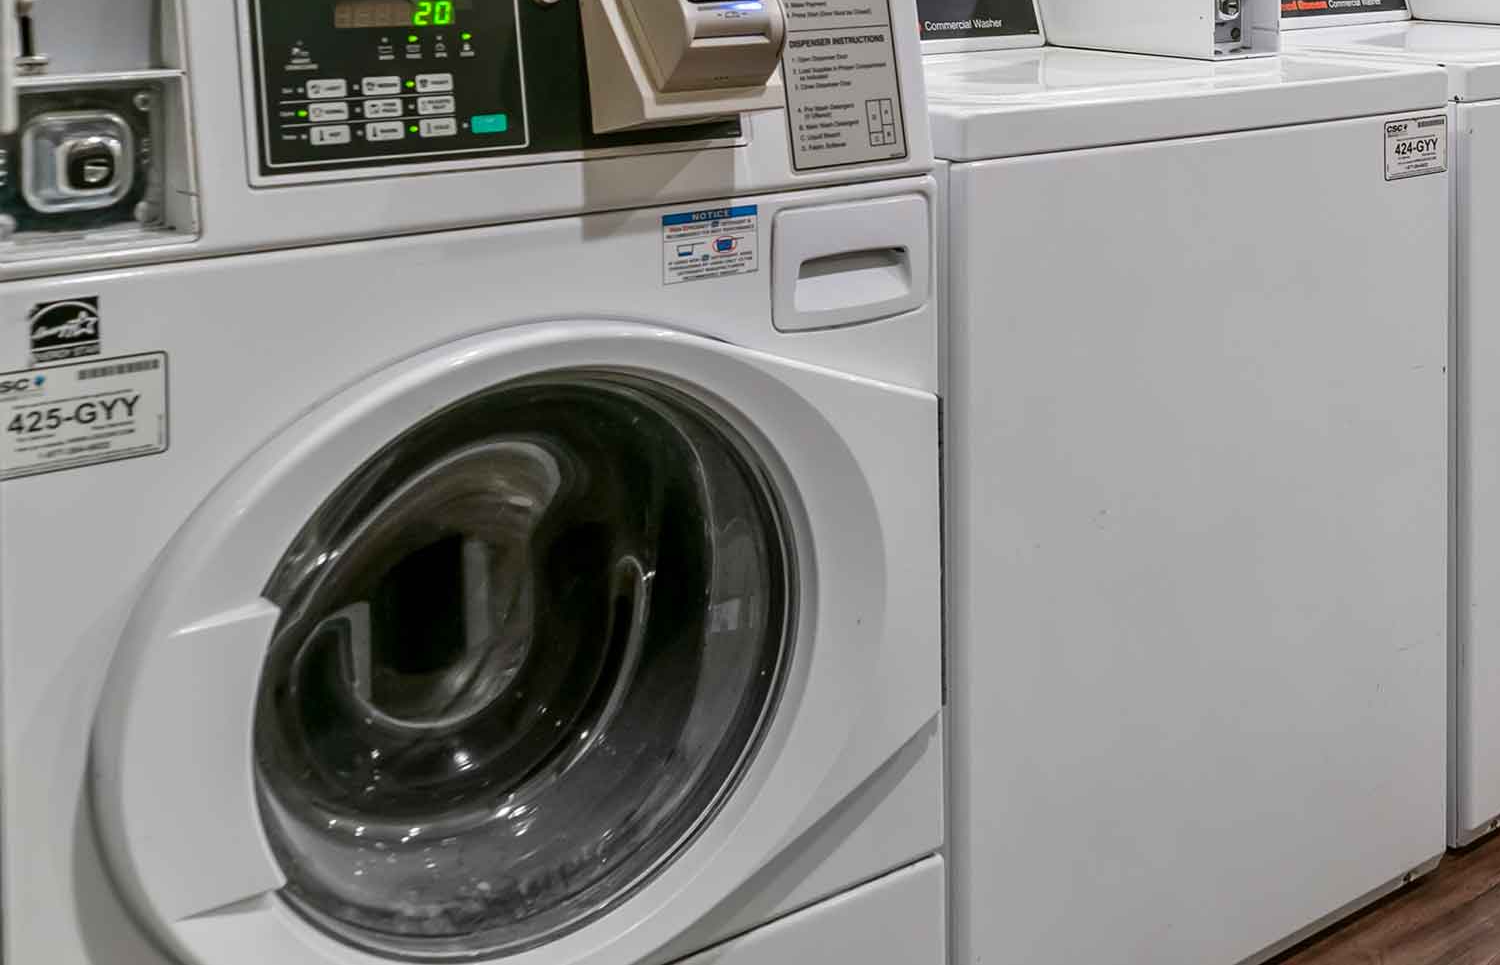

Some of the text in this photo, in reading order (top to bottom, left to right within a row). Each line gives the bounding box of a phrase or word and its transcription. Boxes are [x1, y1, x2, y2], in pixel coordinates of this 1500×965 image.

[1328, 0, 1360, 9] Commercial
[413, 0, 452, 26] 20
[924, 18, 1002, 31] Commercial Washer
[789, 34, 885, 49] DISPENSER INSTRUCTIONS
[1386, 124, 1403, 133] CSC
[1395, 138, 1438, 155] 424-GYY
[691, 209, 731, 221] NOTICE
[8, 394, 141, 434] 425-GYY
